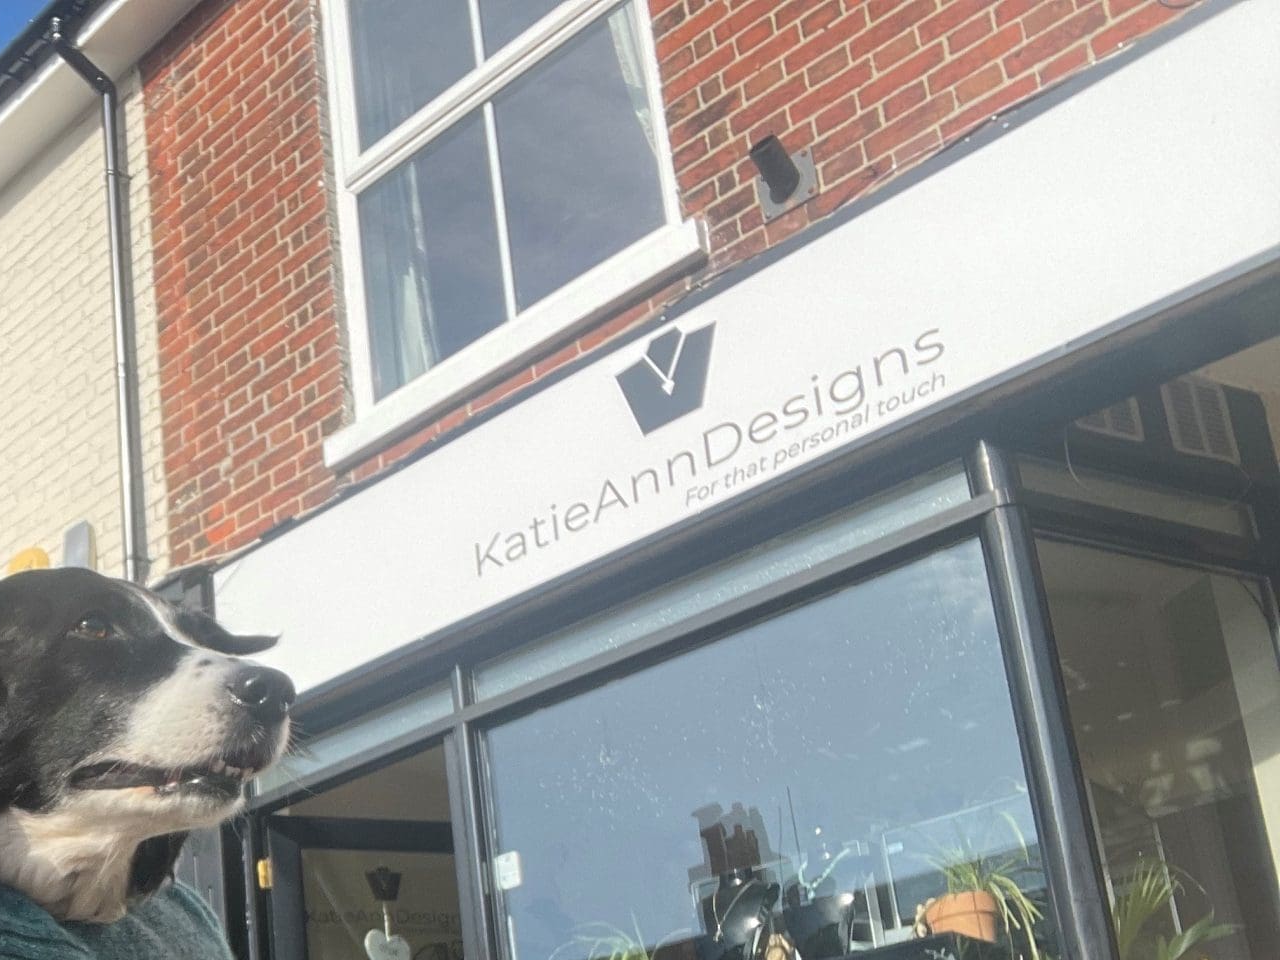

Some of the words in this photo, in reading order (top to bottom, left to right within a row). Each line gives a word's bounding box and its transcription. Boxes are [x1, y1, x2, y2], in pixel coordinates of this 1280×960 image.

[473, 327, 946, 577] KatieAnnDesigns
[685, 479, 719, 507] For
[724, 456, 768, 490] that
[772, 404, 870, 470] personal
[877, 373, 946, 417] touch
